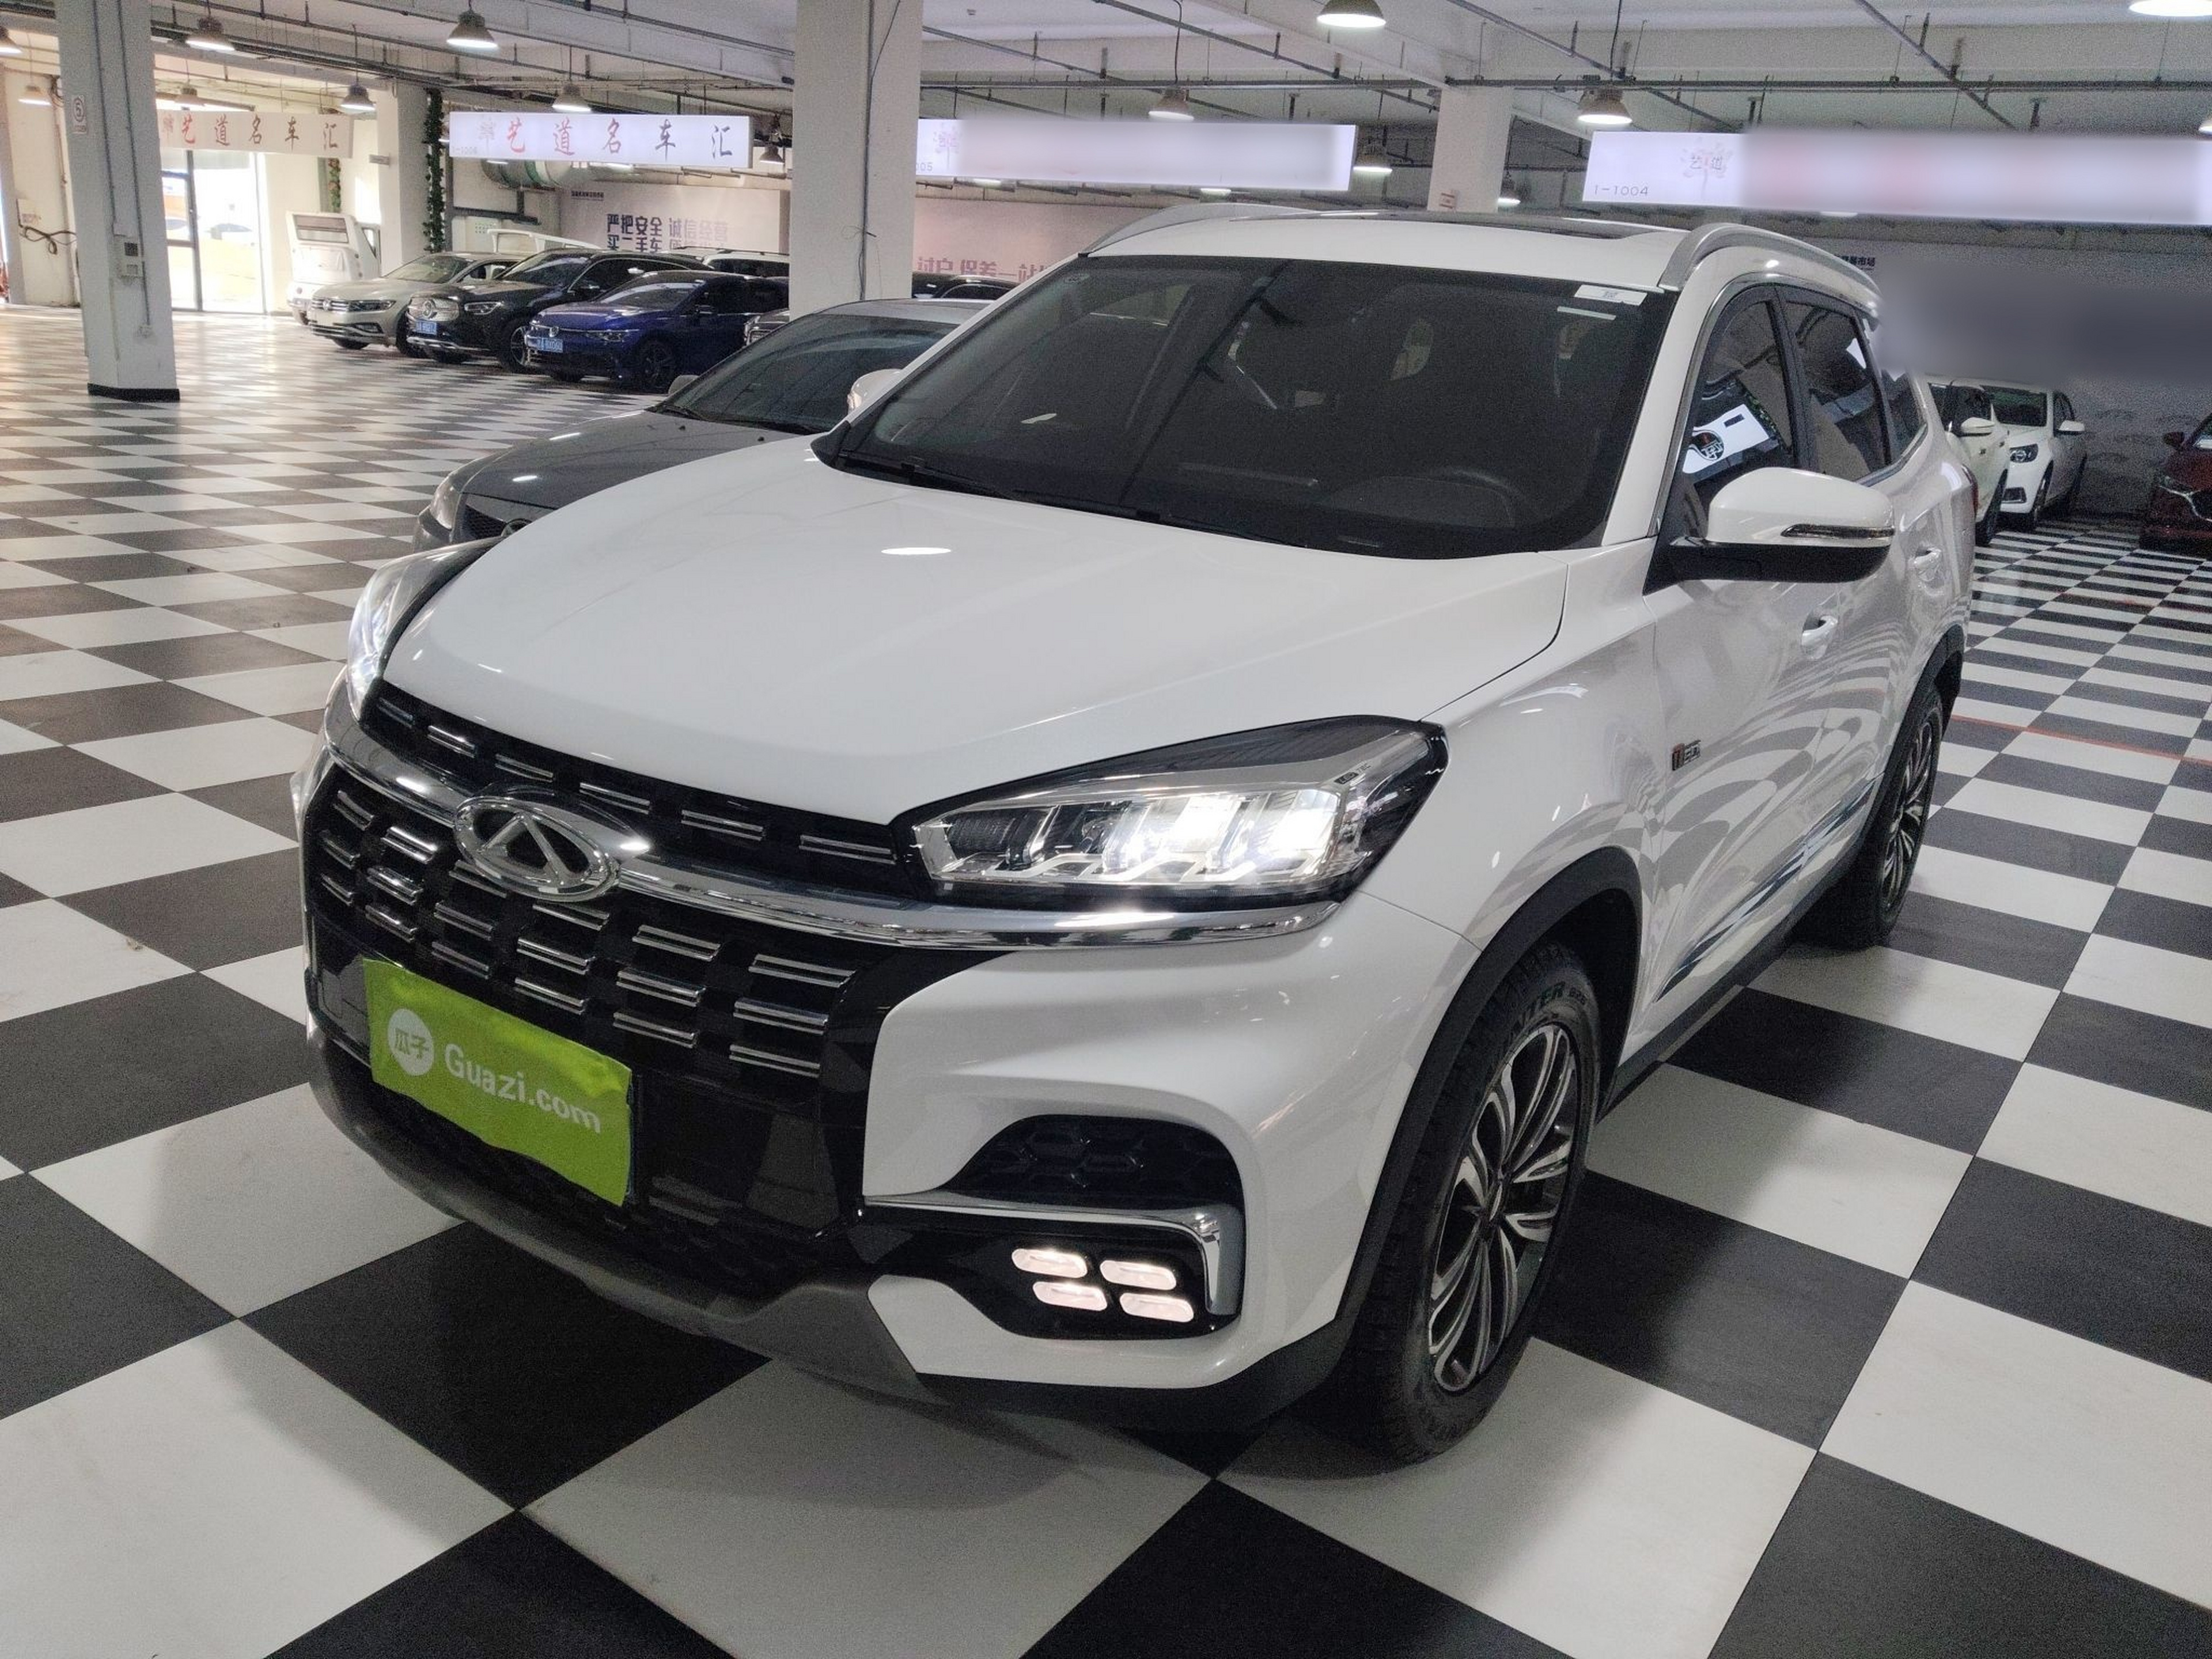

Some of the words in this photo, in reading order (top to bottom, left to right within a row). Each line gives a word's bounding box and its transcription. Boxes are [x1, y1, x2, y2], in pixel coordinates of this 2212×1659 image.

[181, 113, 338, 150] 艺道名车汇
[506, 117, 733, 160] 艺道名车汇
[607, 213, 662, 237] 严把安全
[607, 234, 662, 253] 买二手车
[960, 259, 1048, 283] 保养一站
[394, 1028, 430, 1060] 瓜子
[444, 1044, 601, 1134] Guazi.com
